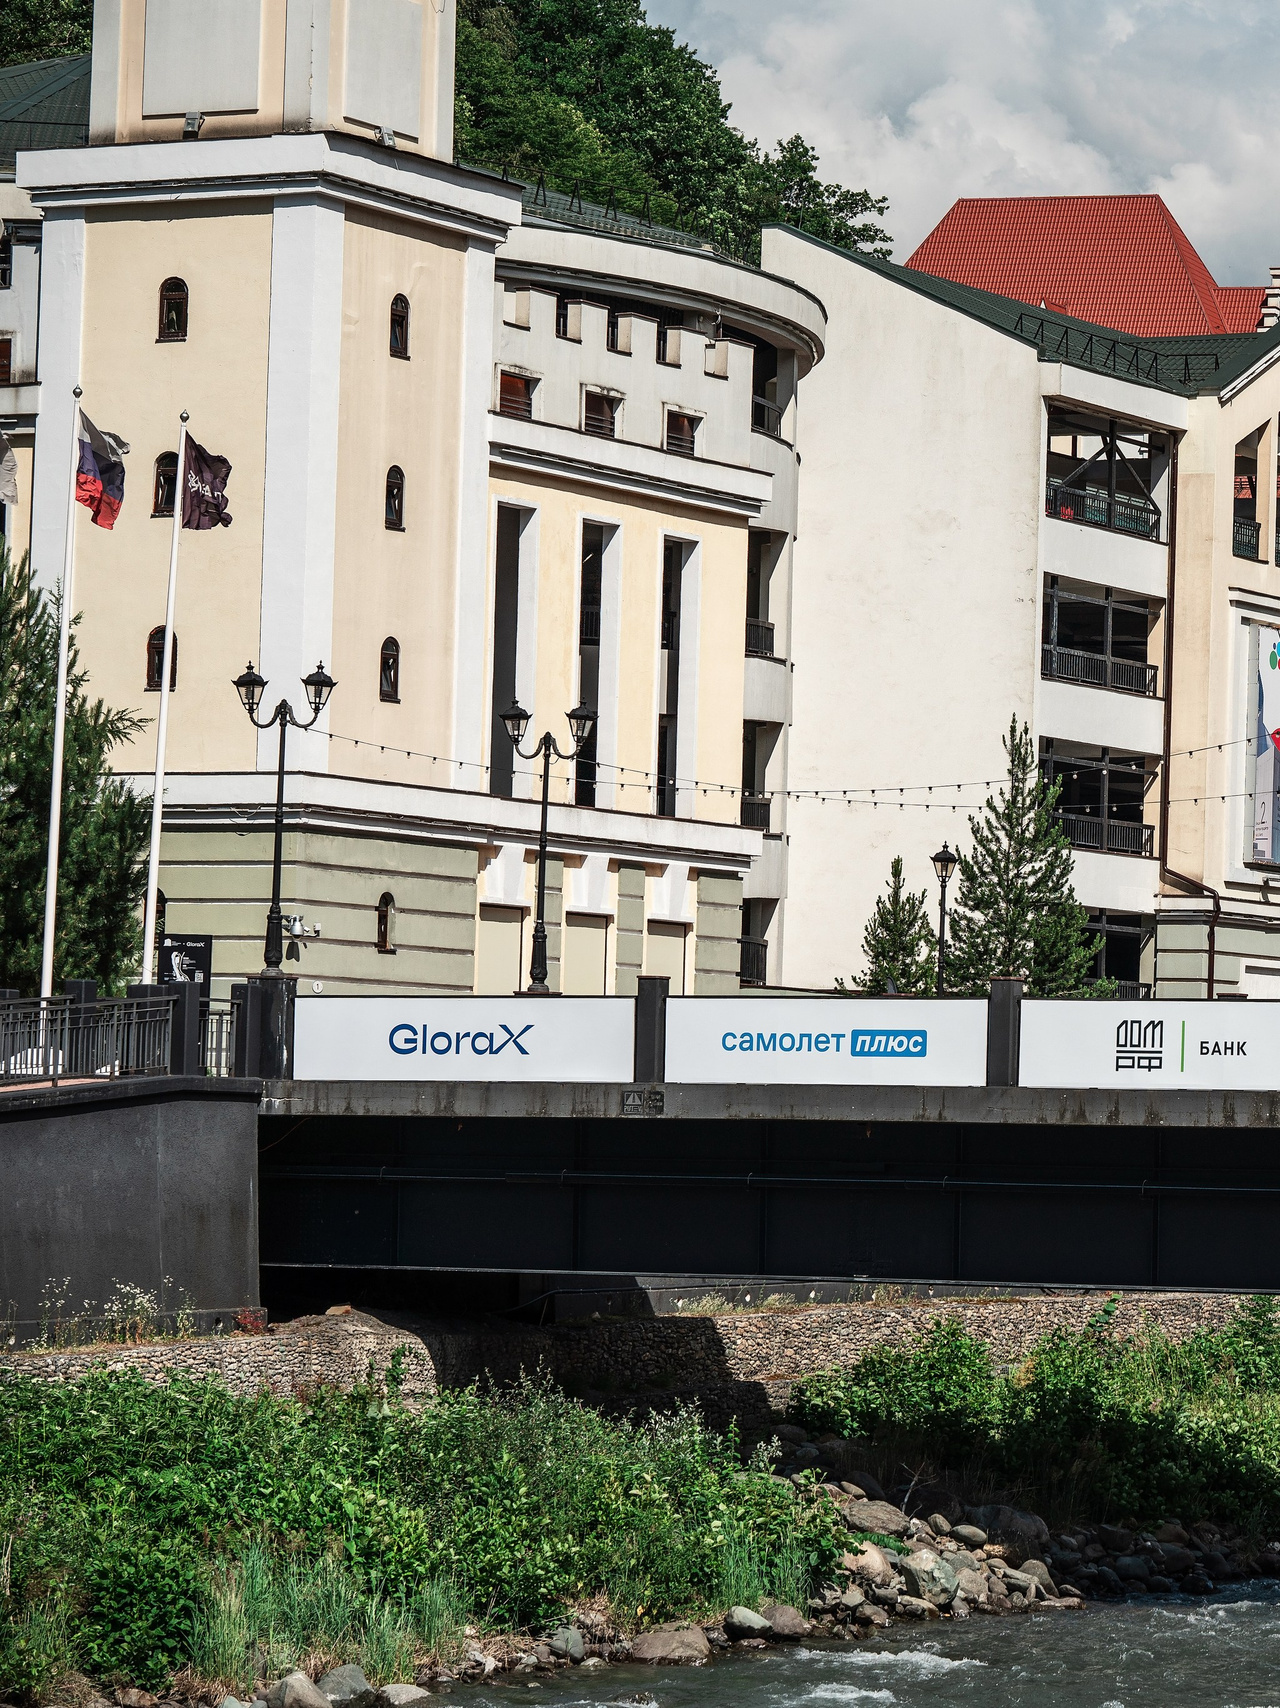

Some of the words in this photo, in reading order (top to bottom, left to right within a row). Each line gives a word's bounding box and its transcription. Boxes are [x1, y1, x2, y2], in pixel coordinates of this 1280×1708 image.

[388, 1023, 535, 1055] GloraX
[721, 1031, 846, 1053] самолет
[855, 1035, 924, 1053] плюс
[1116, 1020, 1164, 1048] ДОМ
[1199, 1041, 1248, 1056] БАНК
[1115, 1056, 1163, 1072] РФ
